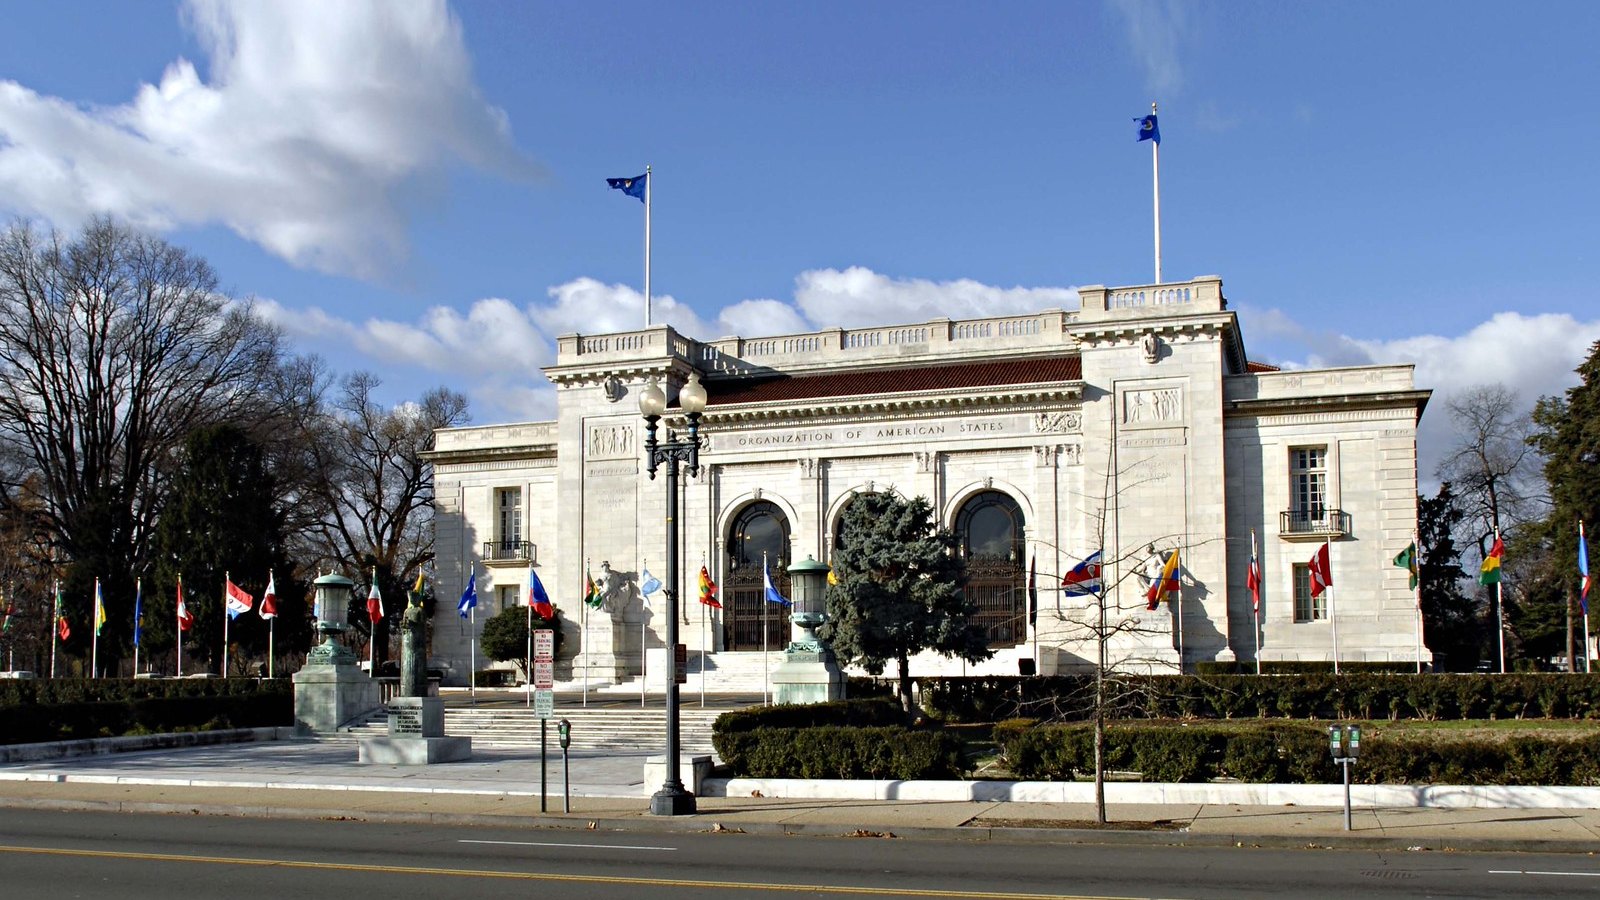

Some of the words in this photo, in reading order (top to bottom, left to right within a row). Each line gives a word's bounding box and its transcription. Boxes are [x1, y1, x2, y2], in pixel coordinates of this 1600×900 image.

[739, 432, 833, 446] ORGANIZATION
[846, 431, 862, 439] OF
[877, 425, 945, 437] AMERICAN
[960, 422, 1003, 432] STATES
